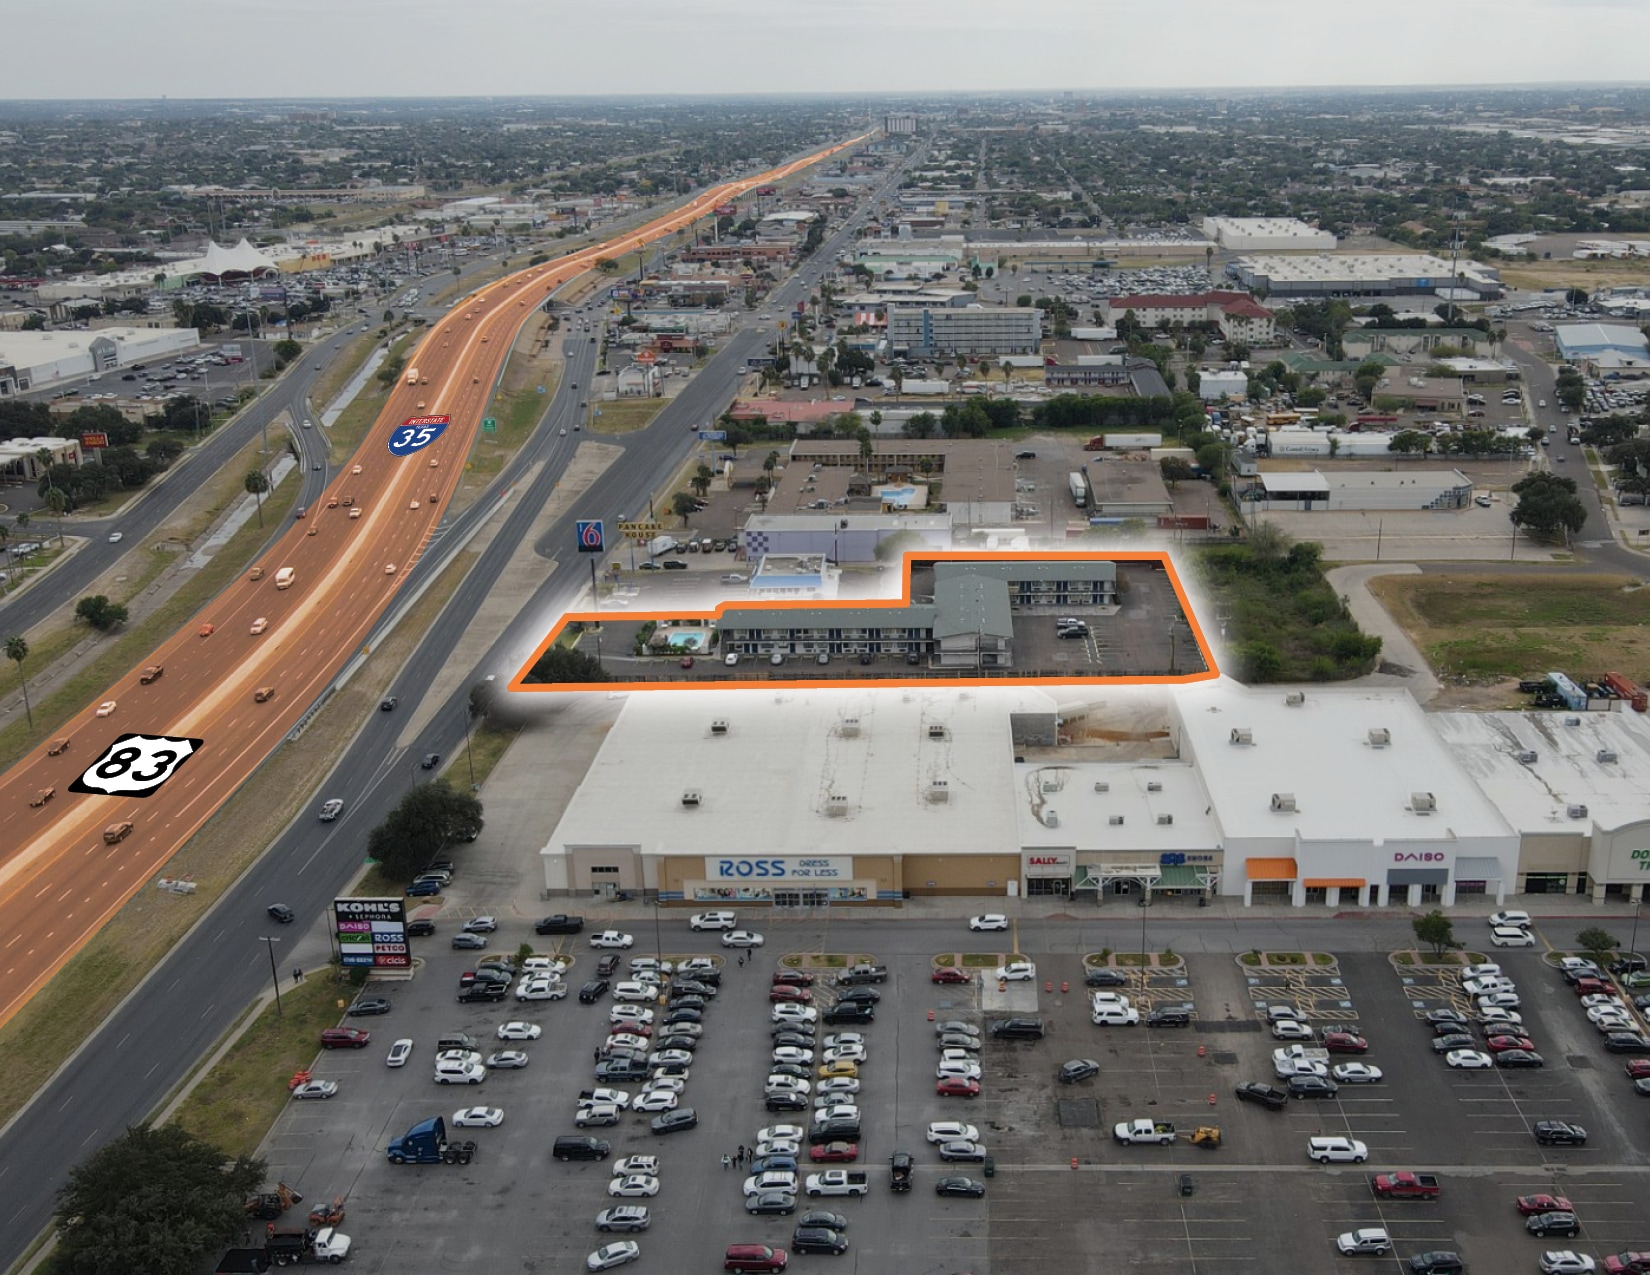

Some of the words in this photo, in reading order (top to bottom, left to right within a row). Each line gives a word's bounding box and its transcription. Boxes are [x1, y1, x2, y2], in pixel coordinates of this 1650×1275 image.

[582, 521, 601, 547] 6
[1029, 857, 1058, 865] SALLY
[1394, 852, 1445, 862] DAISO
[798, 859, 830, 867] DRESS
[720, 860, 786, 877] ROSS
[791, 869, 811, 877] FOR
[814, 869, 839, 877] LESS
[336, 902, 401, 913] KOHL'S
[374, 934, 404, 942] ROSS
